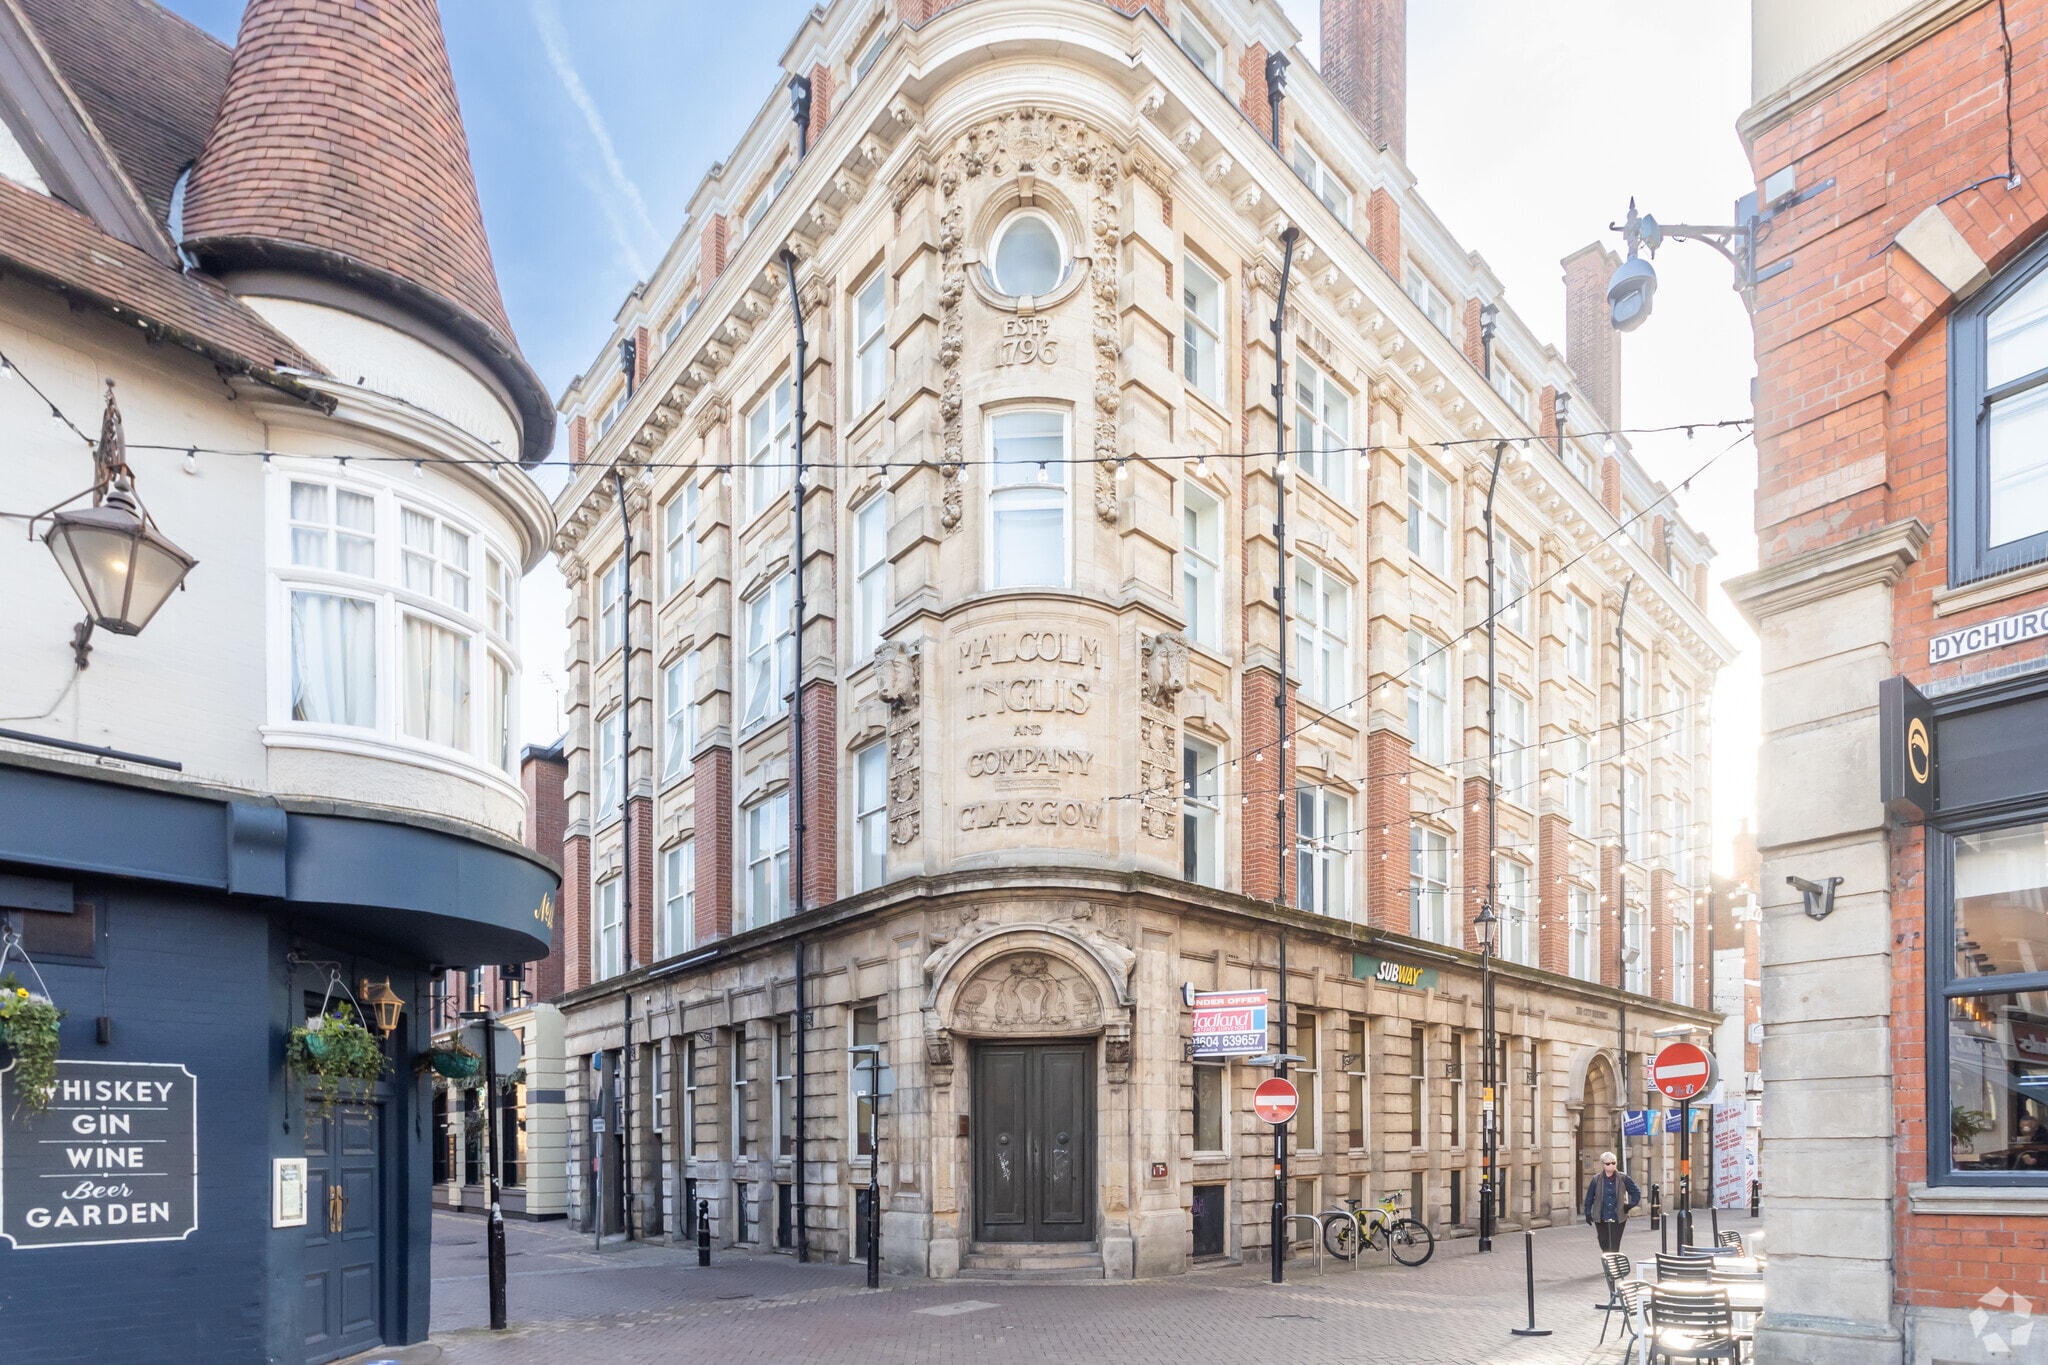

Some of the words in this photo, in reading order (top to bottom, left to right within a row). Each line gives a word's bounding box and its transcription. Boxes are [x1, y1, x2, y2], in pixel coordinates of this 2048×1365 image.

[994, 339, 1059, 369] 1796
[957, 632, 1102, 675] MALCOLM
[966, 679, 1091, 721] INGLIS
[1013, 724, 1043, 737] AND
[966, 748, 1094, 778] COMPANY
[958, 801, 1104, 831] GLASGOW
[1376, 961, 1424, 987] SUBWAY
[1195, 998, 1225, 1007] NDER
[1227, 996, 1261, 1005] OFFER
[1222, 1034, 1260, 1047] 639657
[72, 1114, 130, 1135] GIN
[66, 1147, 144, 1168] WINE
[62, 1181, 134, 1200] Beer
[26, 1202, 170, 1228] GARDEN
